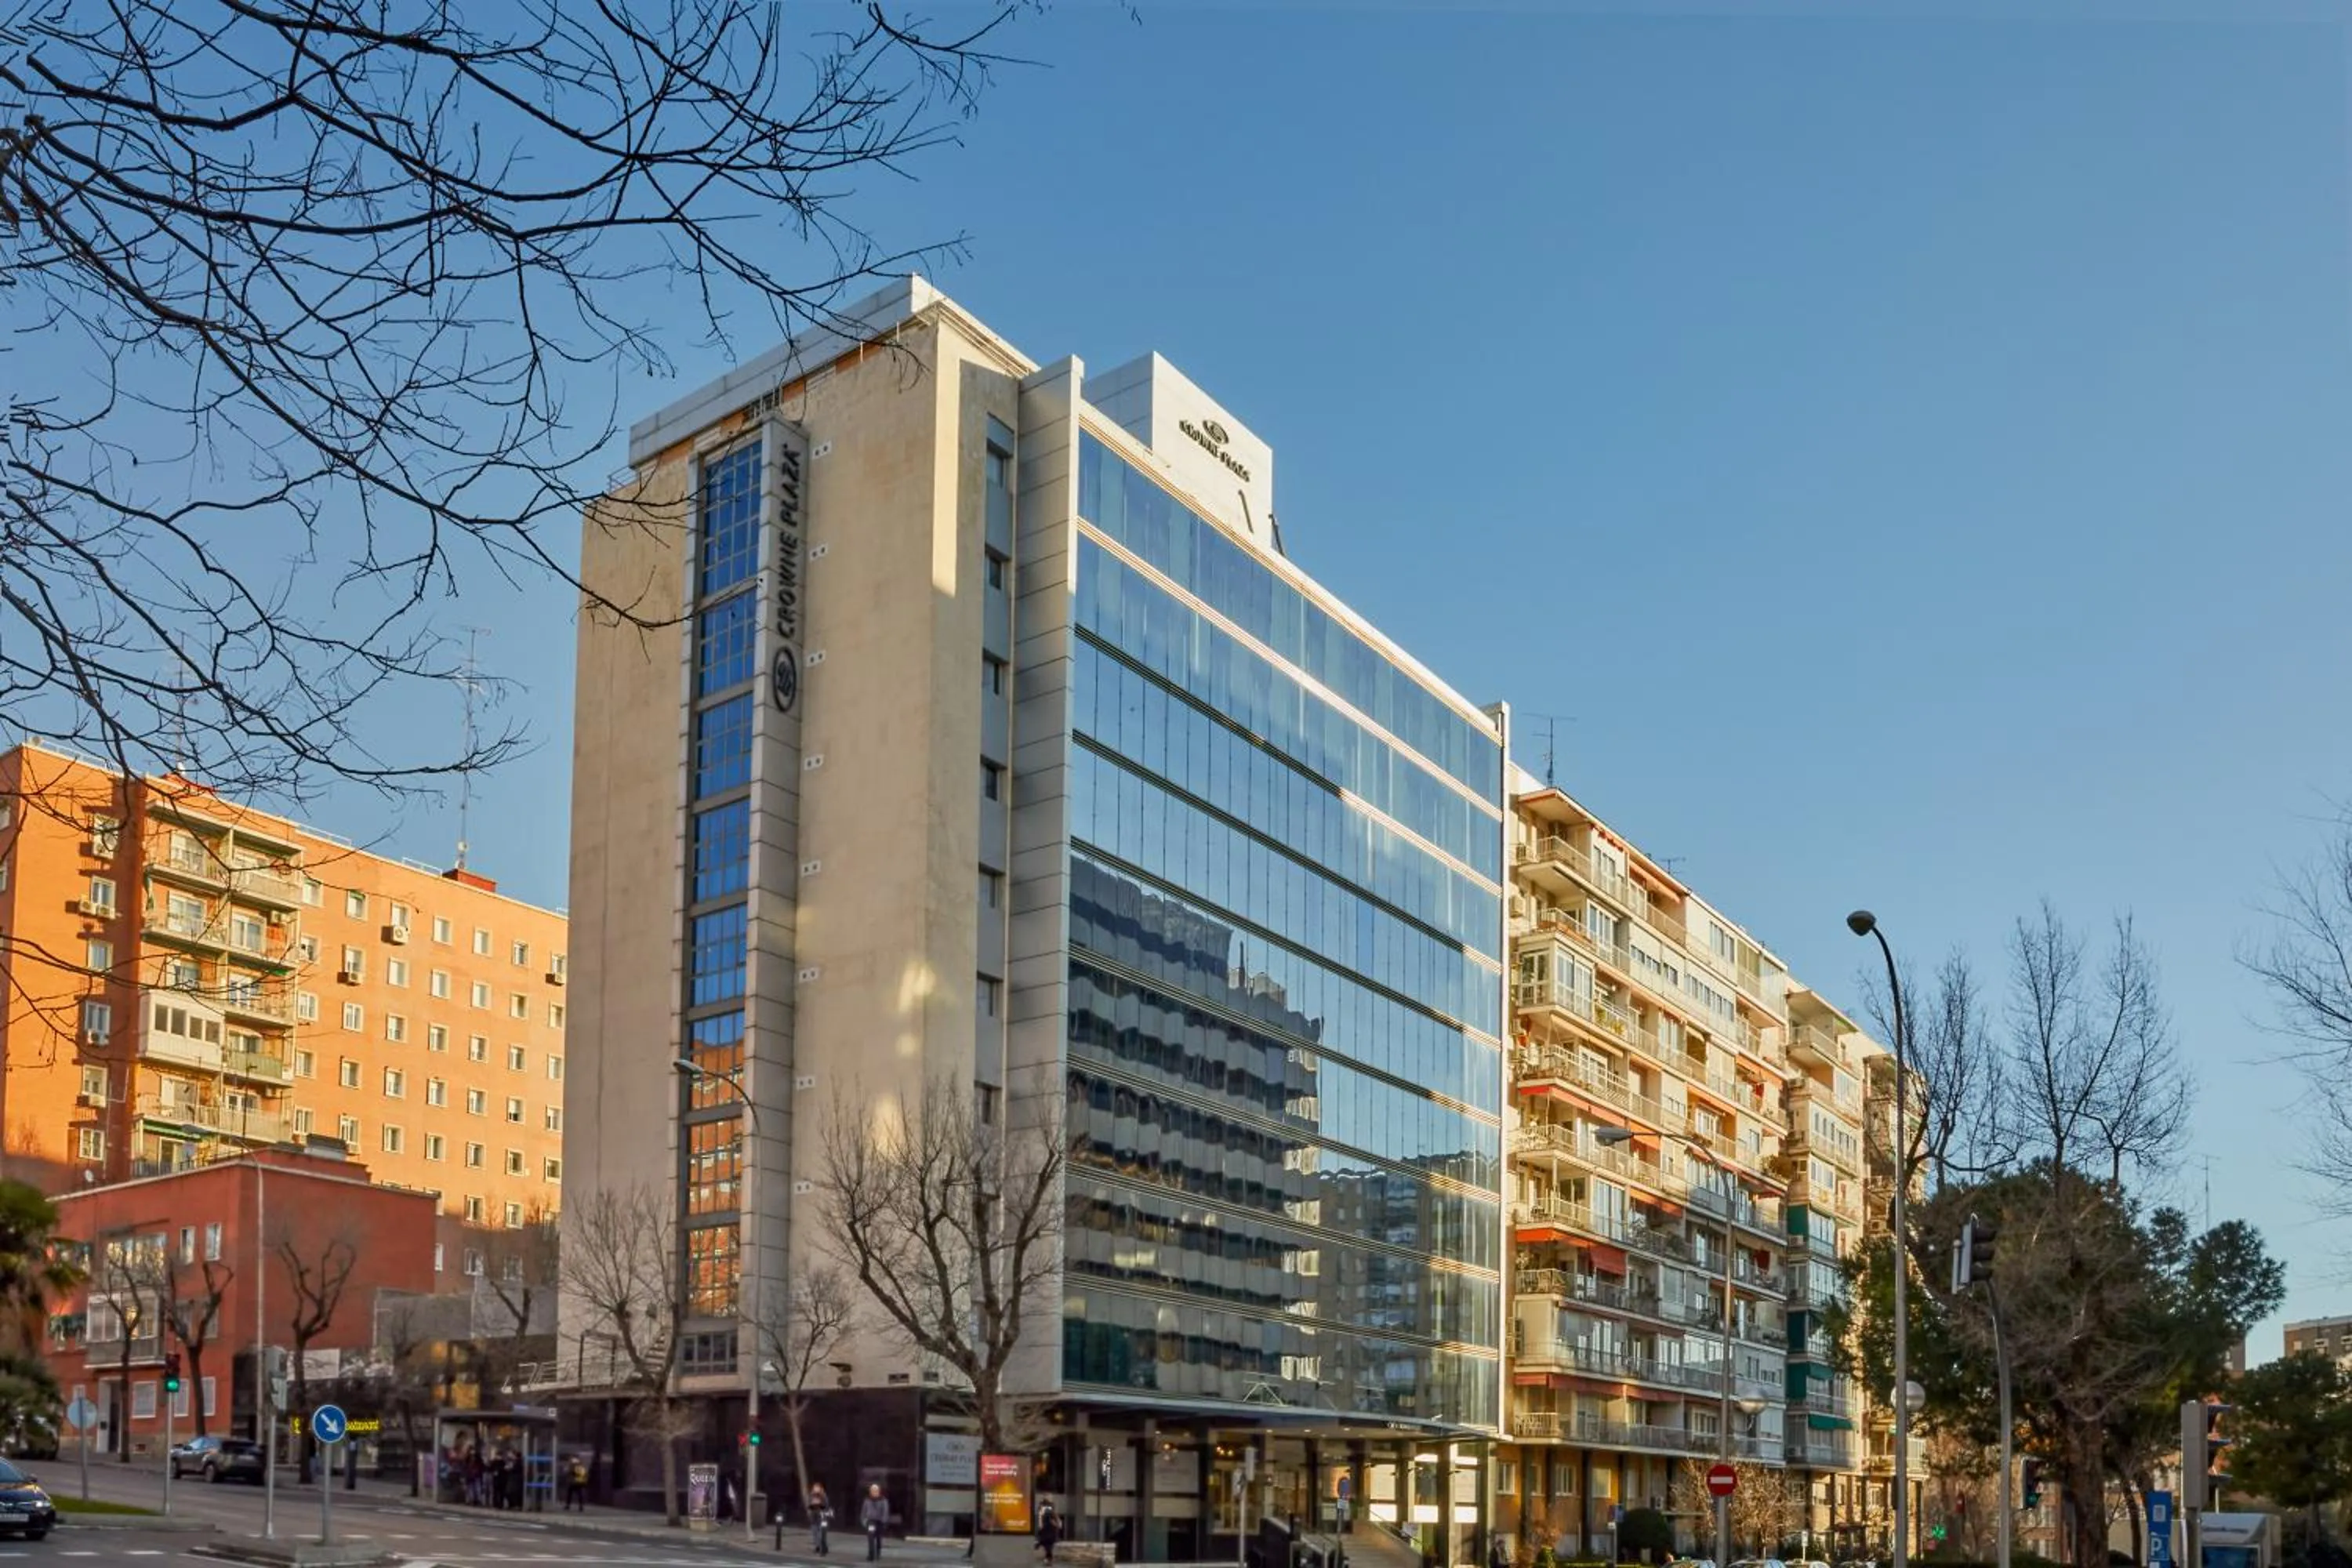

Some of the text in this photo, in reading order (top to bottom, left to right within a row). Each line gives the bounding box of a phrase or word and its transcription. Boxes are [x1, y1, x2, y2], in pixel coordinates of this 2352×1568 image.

[778, 448, 800, 639] CROWNE PLAZA
[2151, 1537, 2162, 1556] P
